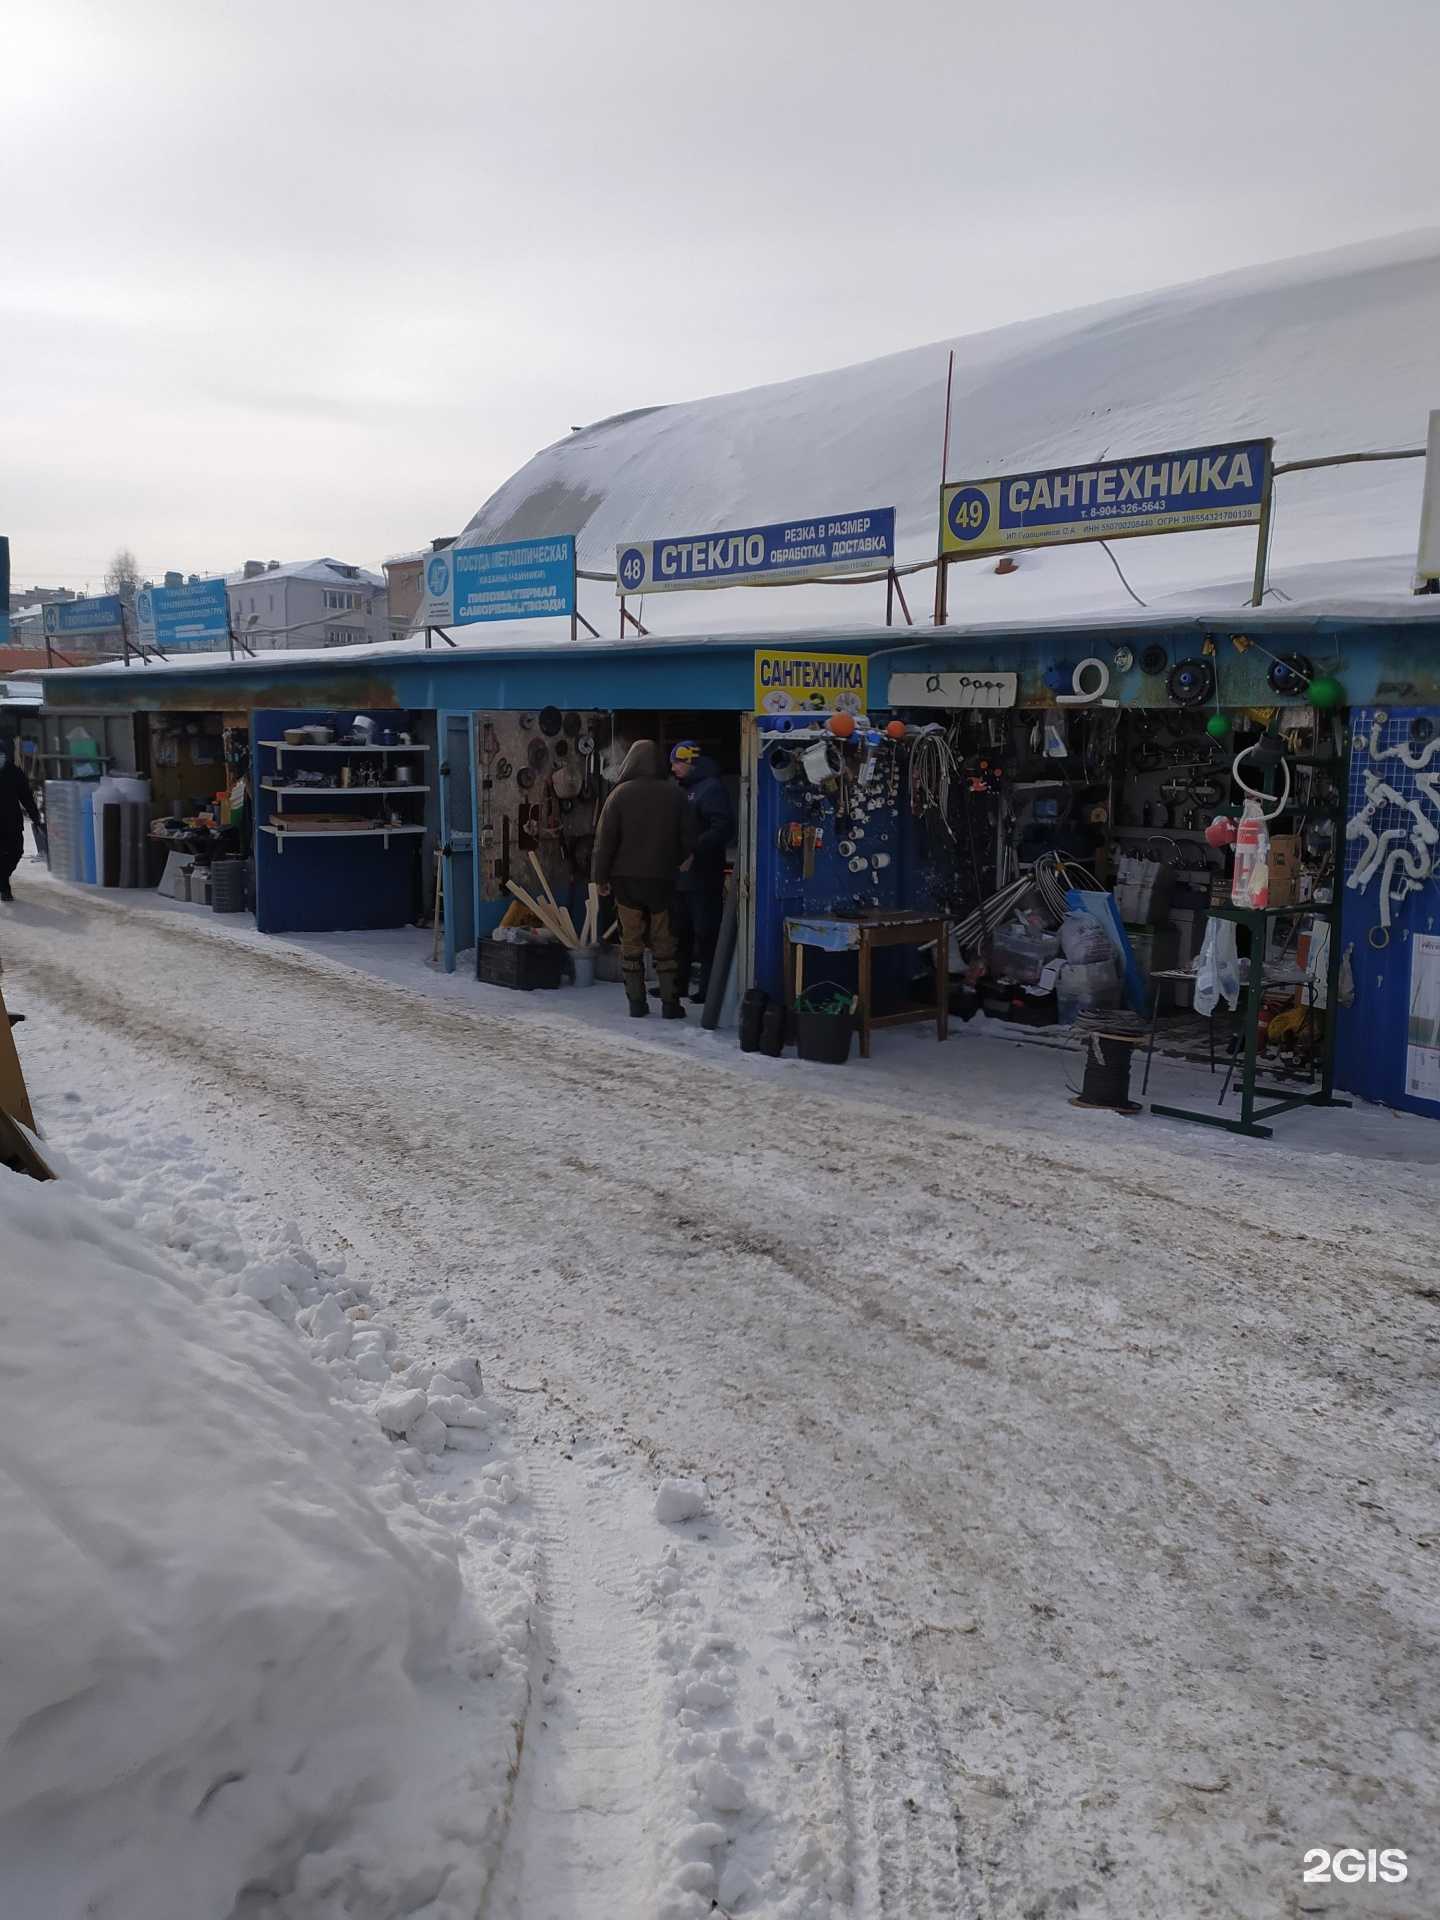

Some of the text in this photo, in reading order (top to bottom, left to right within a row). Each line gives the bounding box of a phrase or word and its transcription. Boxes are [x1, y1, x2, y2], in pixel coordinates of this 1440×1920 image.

[1009, 454, 1253, 512] САНТЕХНИКА
[955, 500, 983, 528] 49
[1090, 500, 1166, 518] 8-904-326-5643
[1157, 516, 1180, 527] ОГРН
[785, 517, 871, 543] РЕЗКА В РАЗМЕР
[661, 534, 765, 575] СТЕКЛО
[770, 535, 887, 563] ОБРАБОТКА ДОСТАВКА
[623, 559, 641, 580] 48
[761, 659, 863, 688] САНТЕХНИКА
